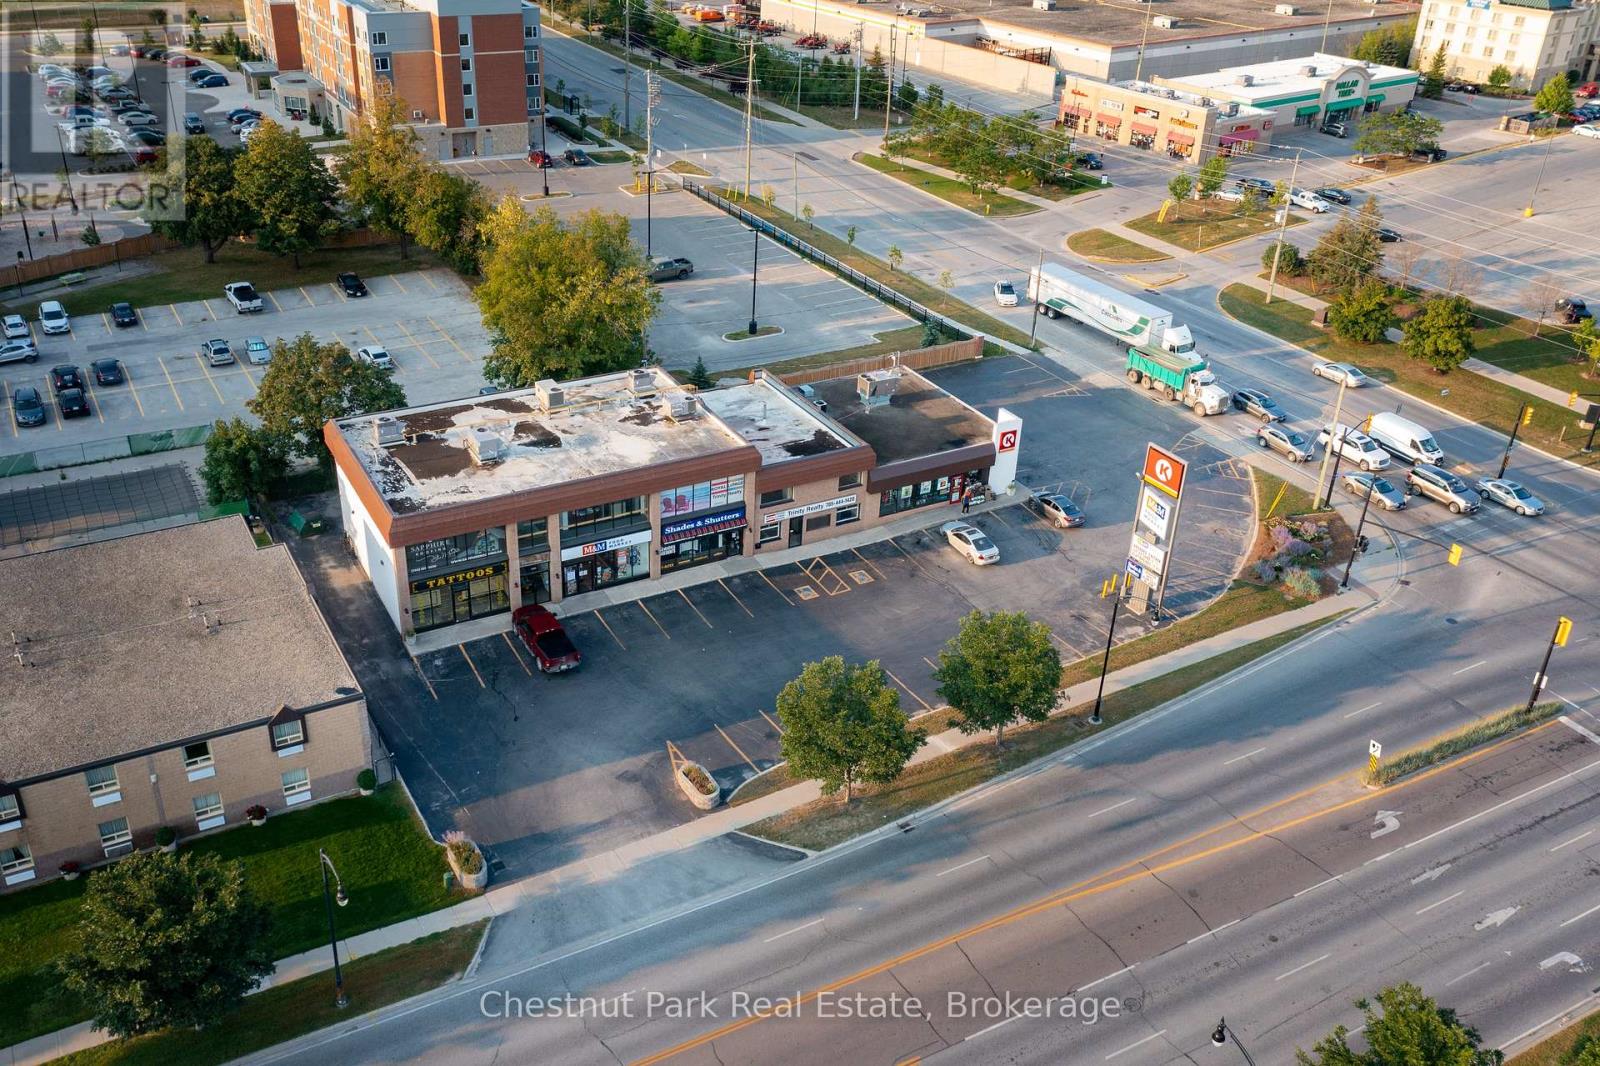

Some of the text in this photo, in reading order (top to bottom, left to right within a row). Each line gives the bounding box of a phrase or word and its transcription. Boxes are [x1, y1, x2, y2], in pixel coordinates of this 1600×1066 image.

[788, 509, 805, 517] Trinity
[806, 503, 824, 512] Realty
[664, 523, 694, 535] Shades
[704, 511, 740, 525] Shutters
[584, 543, 606, 554] M&M
[427, 567, 494, 588] TATTOOS
